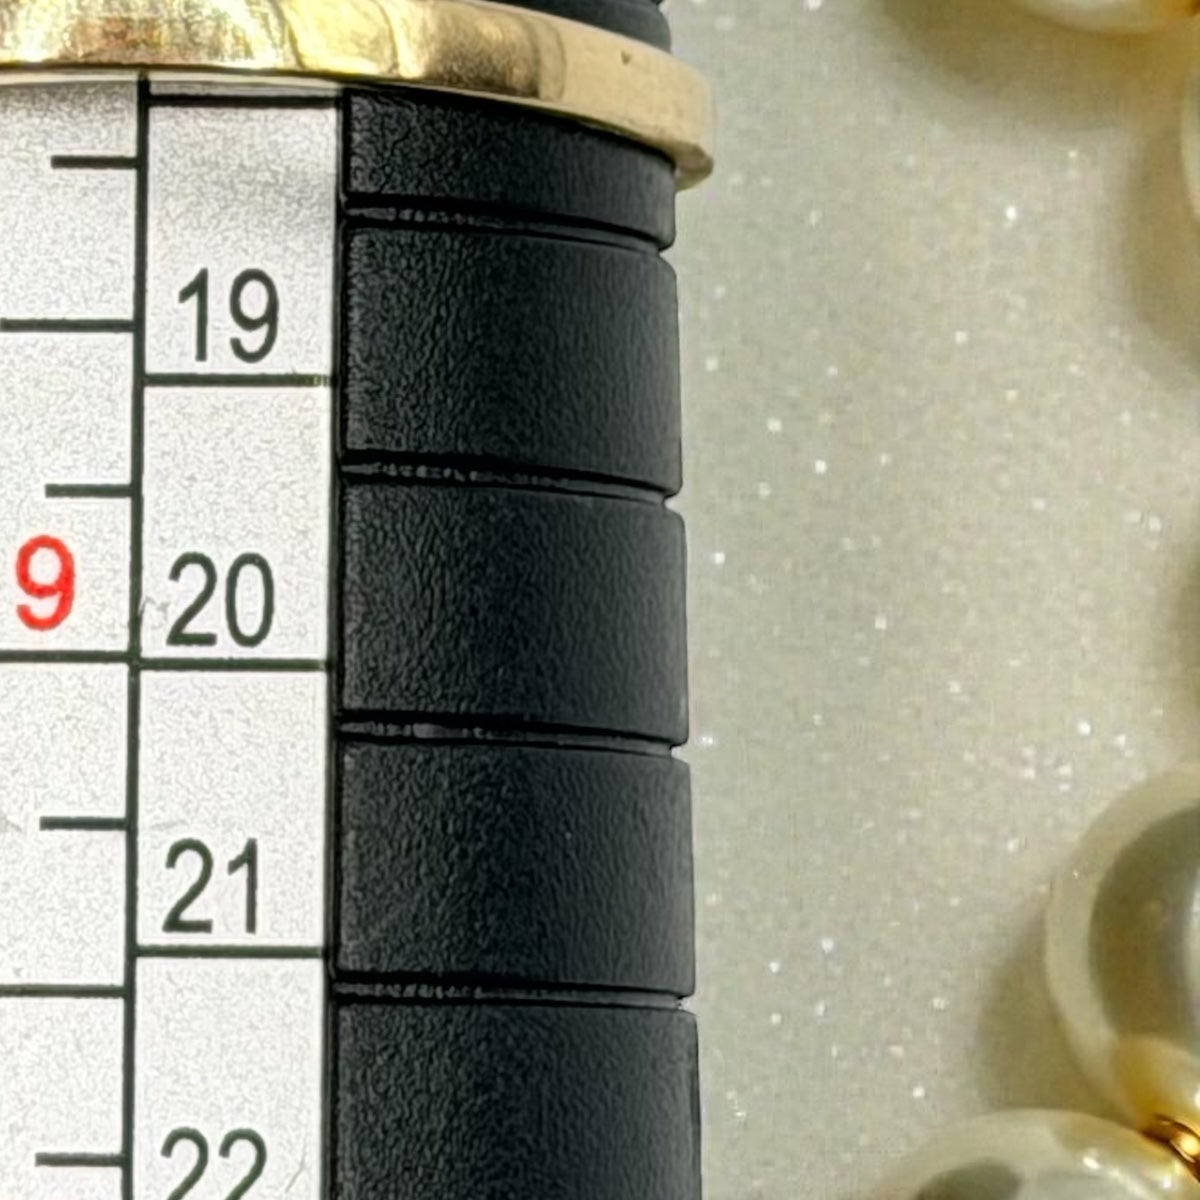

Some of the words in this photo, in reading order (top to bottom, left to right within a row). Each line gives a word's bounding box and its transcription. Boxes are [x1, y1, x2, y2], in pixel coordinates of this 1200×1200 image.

[178, 268, 280, 364] 19
[14, 534, 76, 632] 9
[166, 552, 274, 648] 20
[162, 838, 259, 934] 21
[160, 1127, 267, 1200] 22
